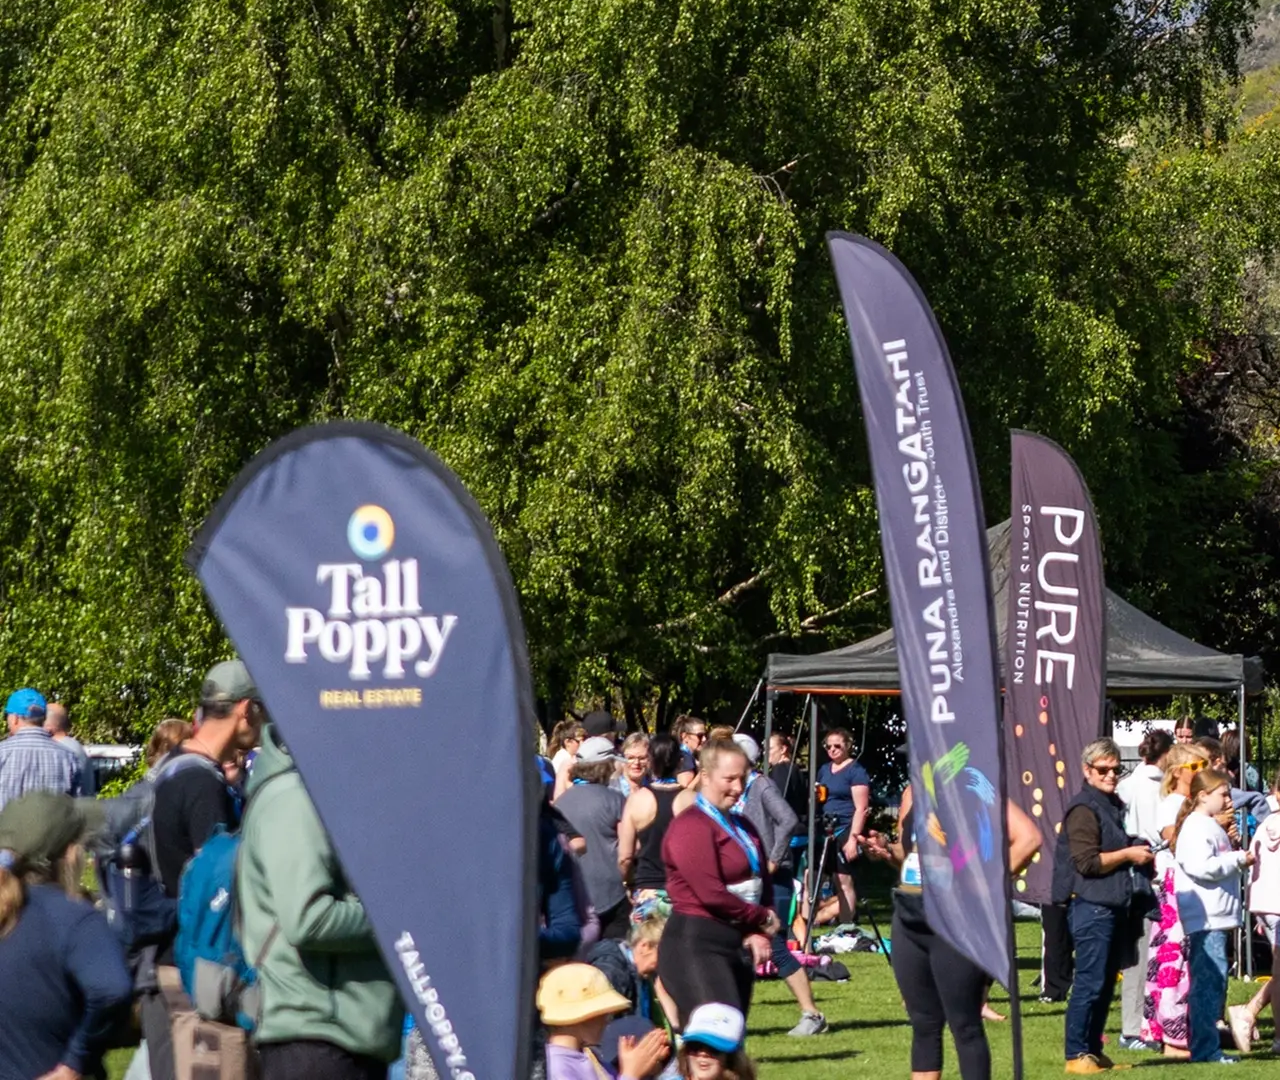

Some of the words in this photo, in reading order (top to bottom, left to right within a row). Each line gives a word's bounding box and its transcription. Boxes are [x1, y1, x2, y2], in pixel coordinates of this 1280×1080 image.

[914, 370, 931, 417] Trust
[882, 339, 943, 588] RANGATAHI
[316, 558, 423, 618] Tall
[938, 550, 953, 584] and
[1034, 506, 1085, 690] PURE
[284, 607, 459, 680] Poppy
[922, 596, 956, 724] PUNA
[946, 588, 965, 683] Alexandra
[1013, 582, 1031, 684] NUTRITION
[320, 689, 362, 709] REAL
[363, 687, 423, 708] ESTATE
